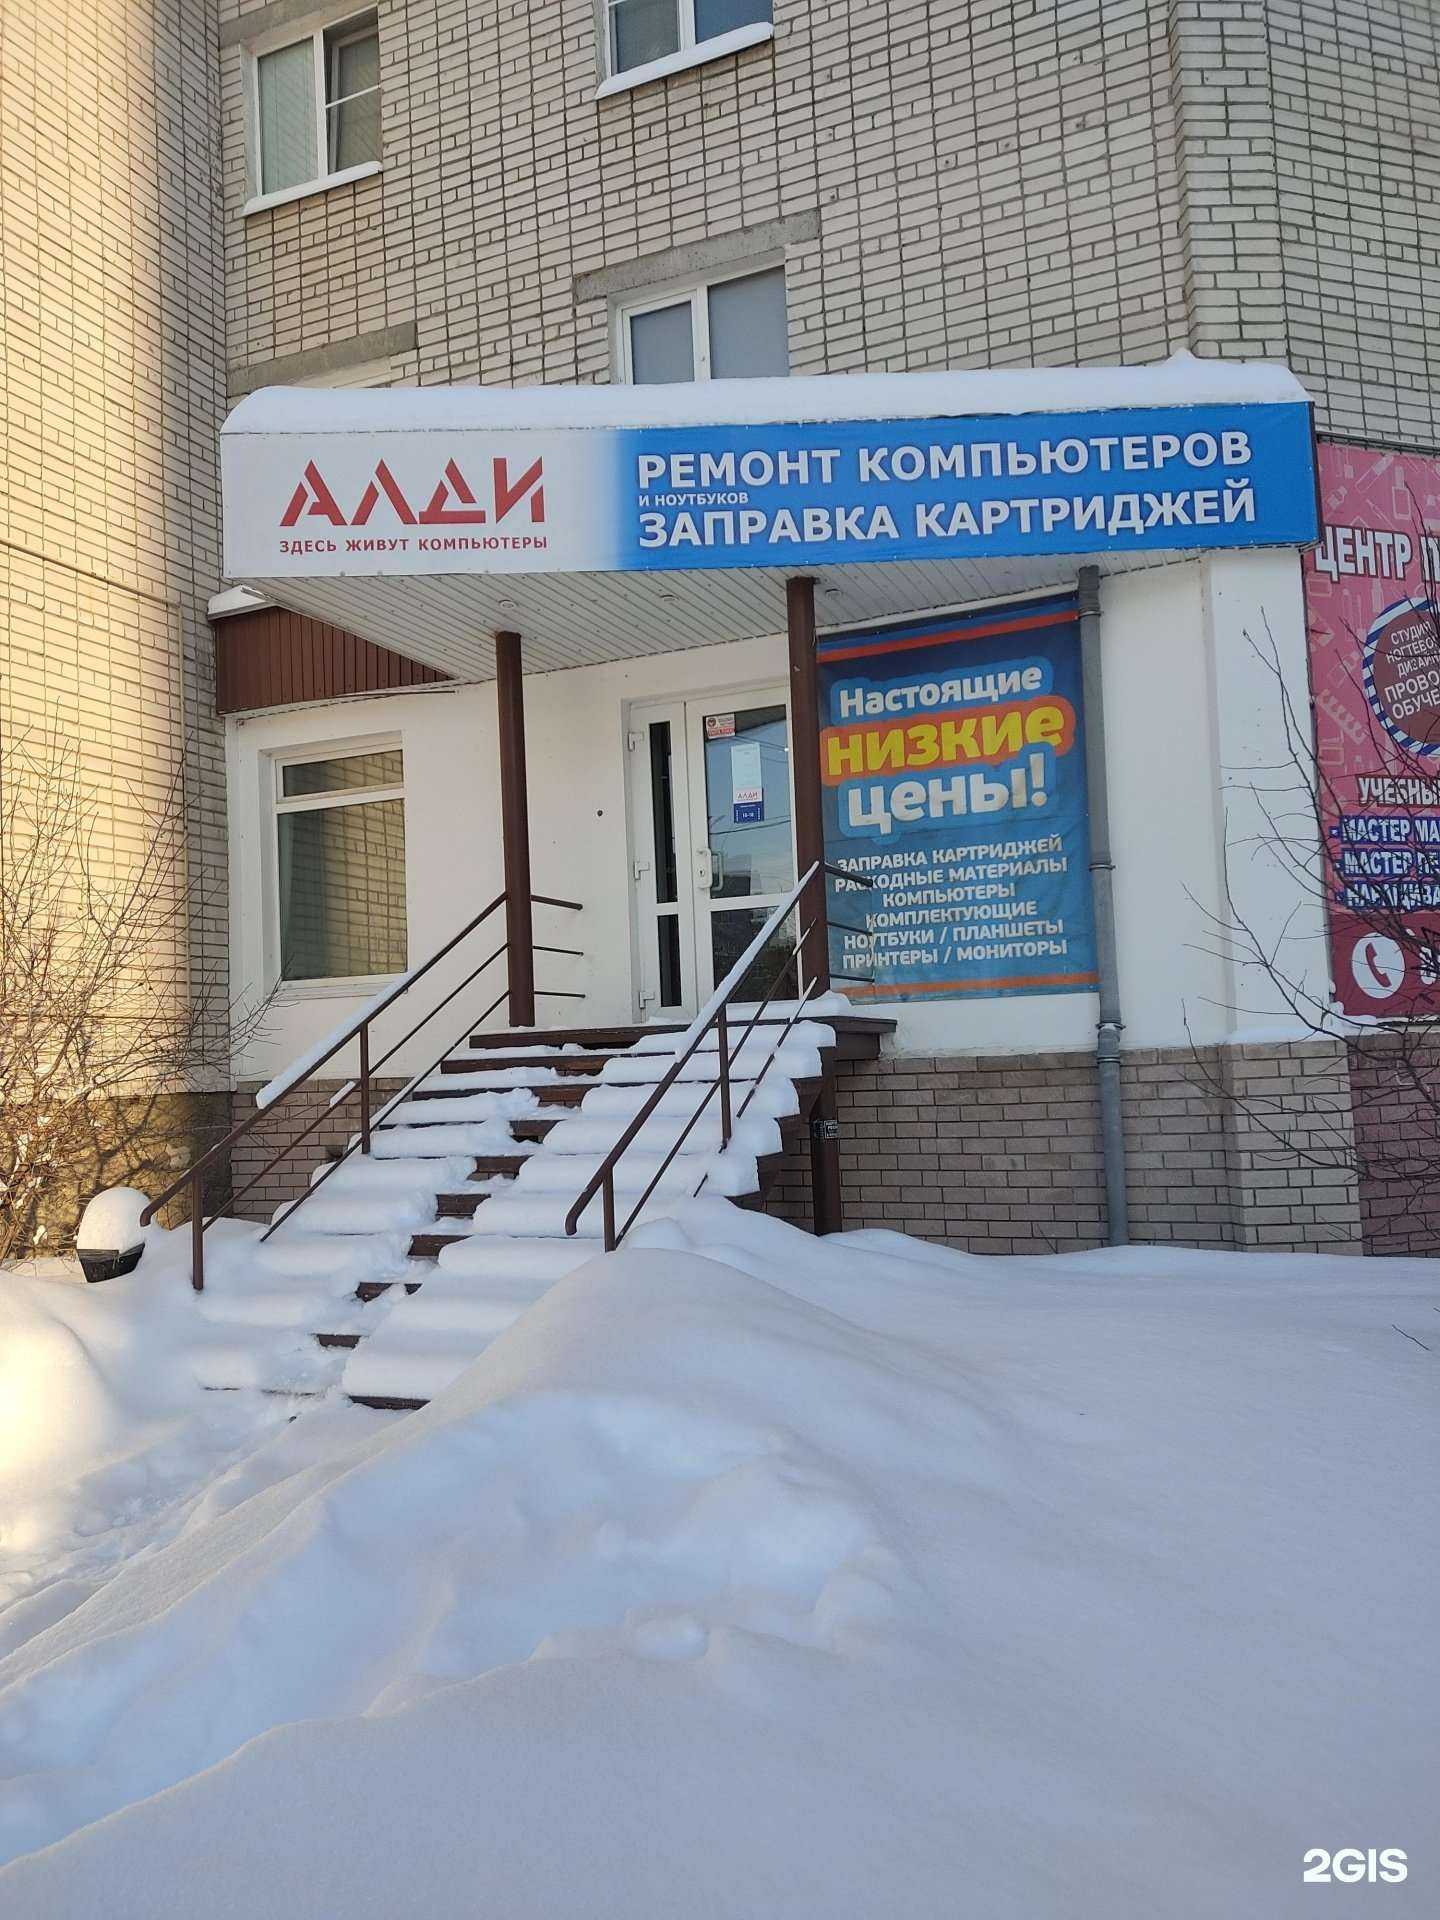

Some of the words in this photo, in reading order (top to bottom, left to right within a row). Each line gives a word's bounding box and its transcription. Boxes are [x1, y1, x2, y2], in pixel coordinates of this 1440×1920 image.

[638, 448, 841, 489] РЕМОНТ
[859, 431, 1252, 482] КОМПЬЮТЕРОВ
[279, 455, 545, 527] АЛДИ
[639, 495, 650, 506] И
[654, 491, 749, 506] НОУТБУКОВ
[639, 505, 899, 548] ЗАПРАВКА
[916, 478, 1255, 538] КАРТРИДЖЕЙ
[279, 539, 337, 555] ЗДЕСЬ
[346, 537, 409, 553] ЖИВУТ
[419, 536, 547, 552] КОМПЬЮТЕРЫ
[1315, 526, 1411, 581] ЦЕНТР
[840, 666, 1042, 718] Настоящие
[1384, 670, 1440, 702] ПРОВО
[1392, 688, 1440, 719] ОБУЧЕ
[848, 752, 1048, 835] цены!
[1359, 777, 1440, 805] УЧЕБНЫ
[1343, 818, 1410, 841] МАСТЕР
[1414, 819, 1440, 841] МА
[837, 851, 928, 873] ЗАПРАВКА
[932, 833, 1062, 863] КАРТРИДЖЕЙ
[1344, 851, 1412, 874] МАСТЕР
[949, 857, 1067, 882] МАТЕРИАЛЫ
[883, 883, 1015, 907] КОМПЬЮТЕРЫ
[866, 901, 1038, 928] КОМПЛЕКТУЮЩИЕ
[844, 929, 934, 949] НОУТБУКИ
[953, 919, 1063, 941] ПЛАНШЕТЫ
[843, 949, 938, 969] ПРИНТЕРЫ
[957, 940, 1067, 961] МОНИТОРЫ
